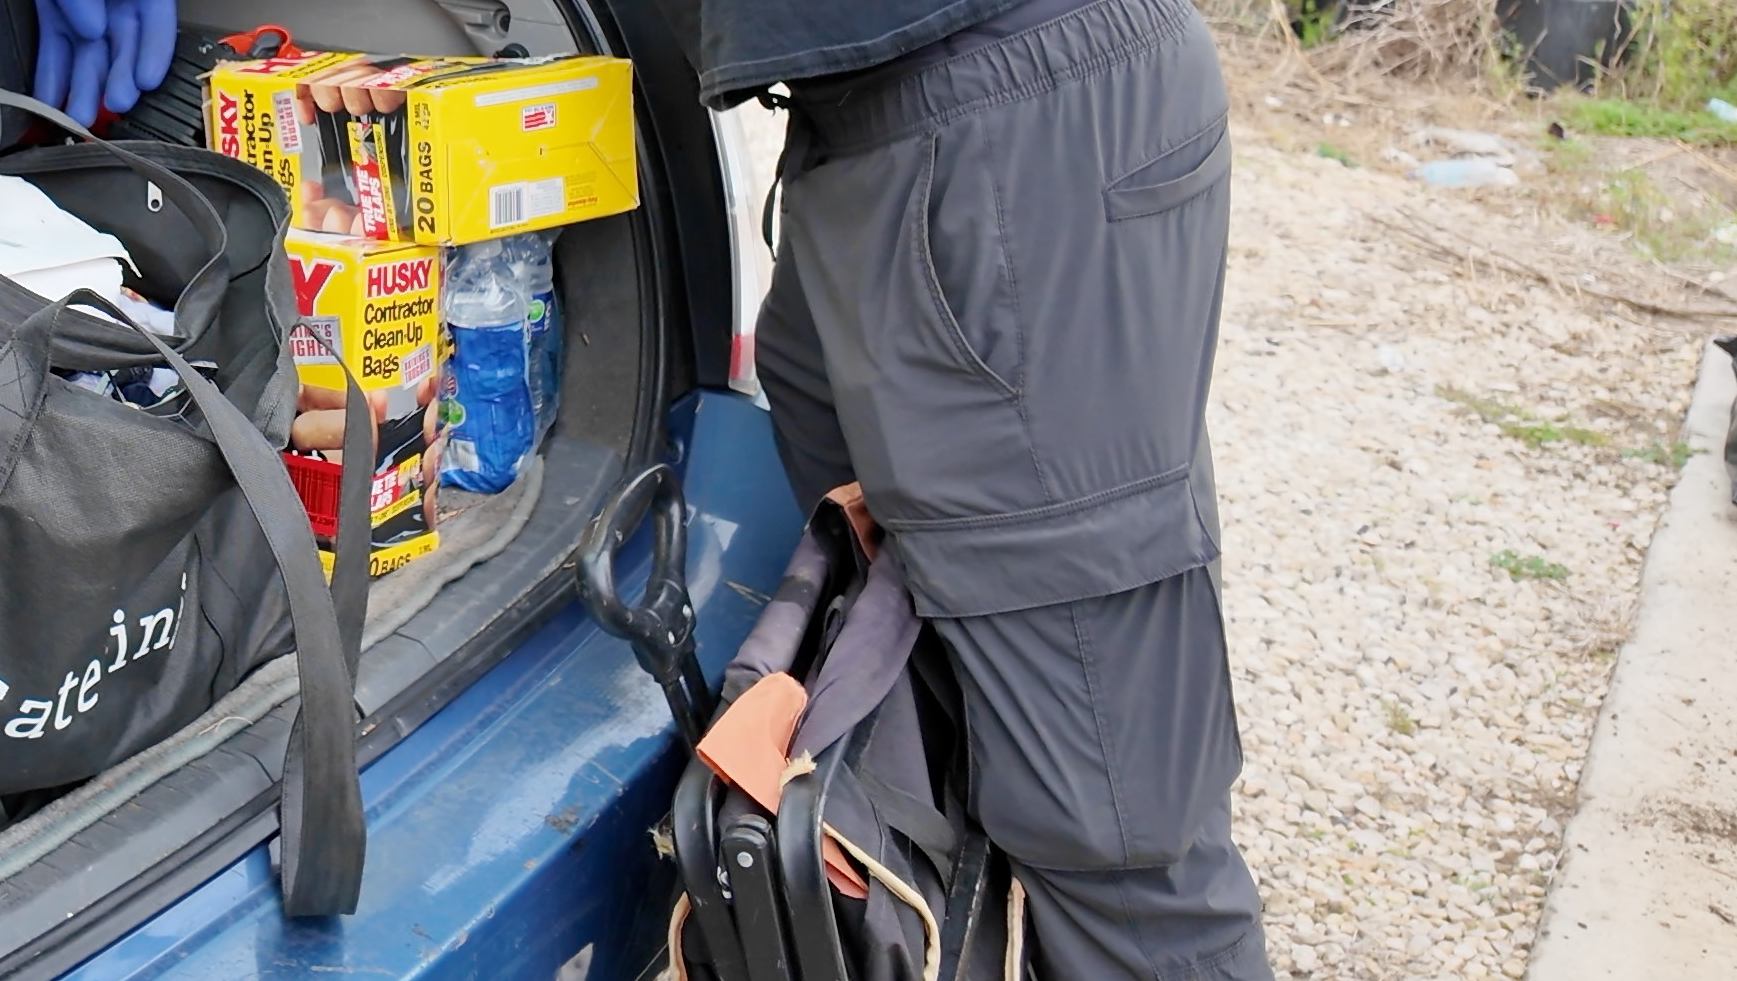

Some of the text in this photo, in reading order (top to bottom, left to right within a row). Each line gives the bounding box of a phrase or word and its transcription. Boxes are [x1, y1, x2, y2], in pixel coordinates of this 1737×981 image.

[219, 91, 240, 160] SKY
[242, 89, 257, 168] ractor
[258, 112, 275, 177] an-Up
[356, 166, 377, 232] TRUE TIE
[369, 177, 386, 224] FLAPS
[417, 141, 435, 234] 20 BAGS
[367, 258, 433, 298] HUSKY
[363, 321, 423, 351] Clean-Up
[364, 295, 434, 325] Contractor
[362, 354, 400, 379] Bags
